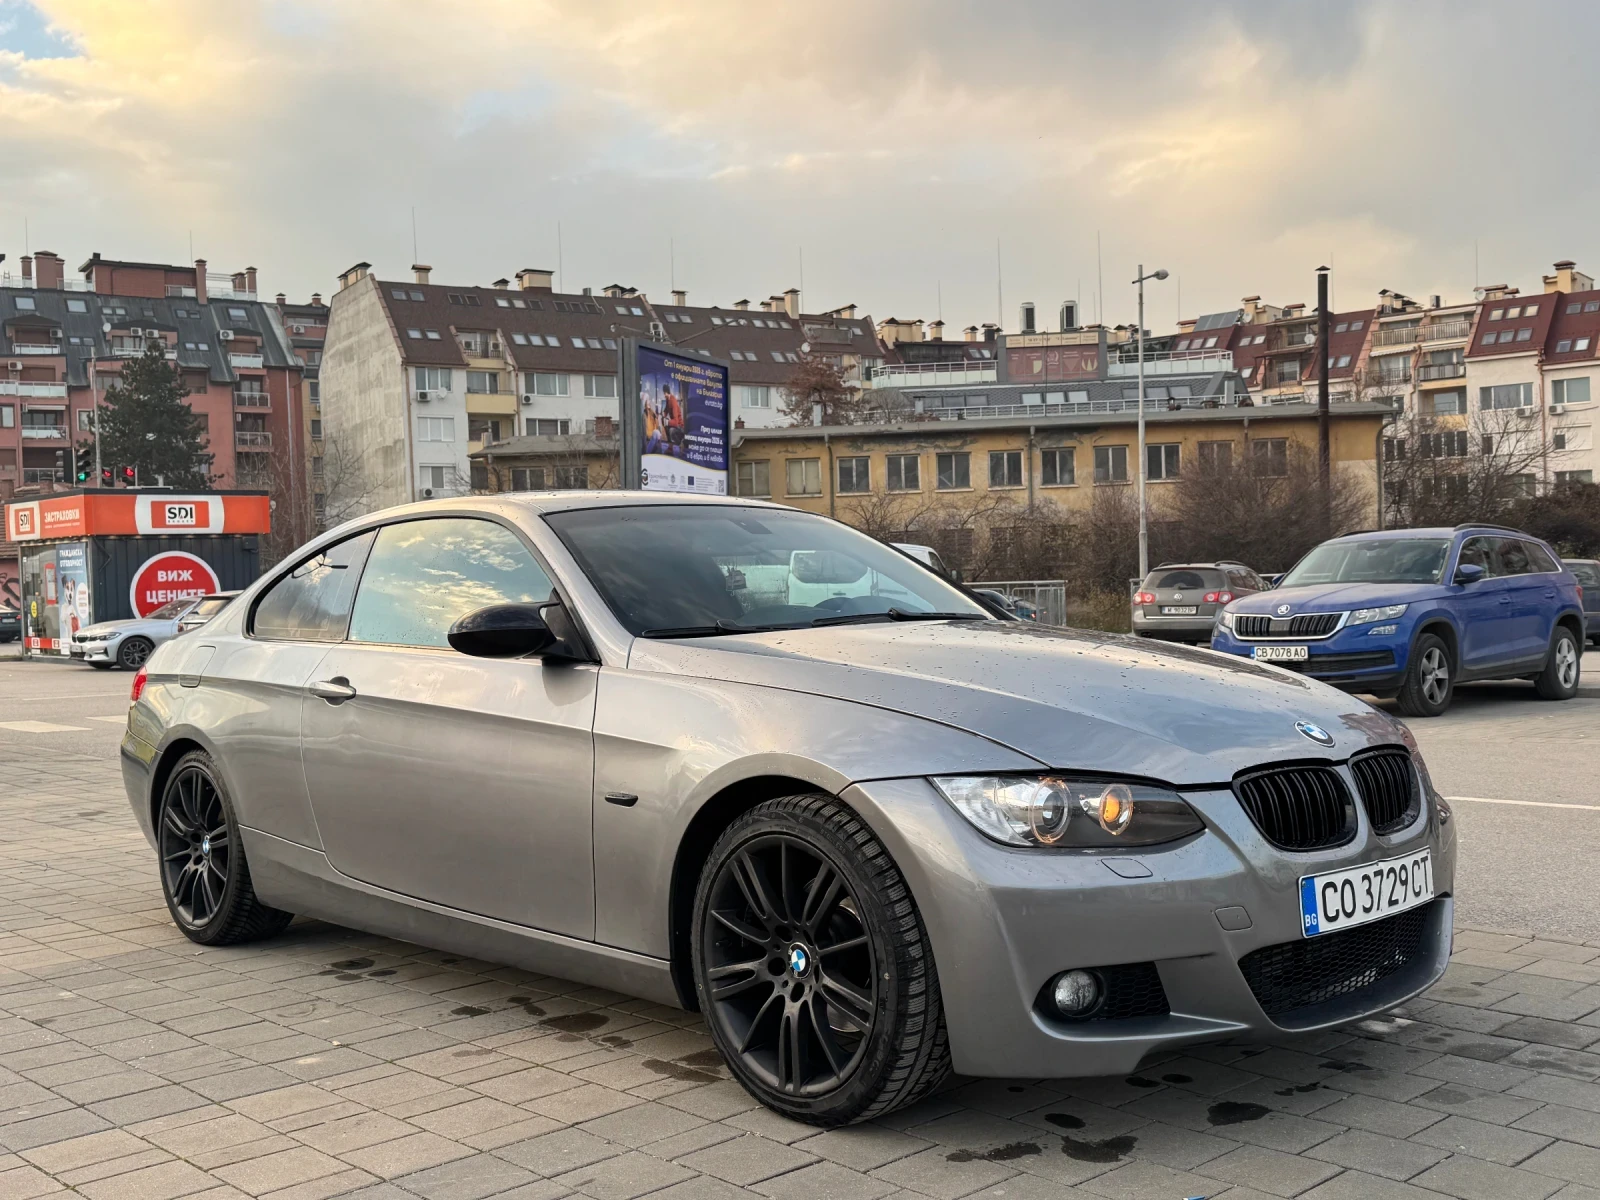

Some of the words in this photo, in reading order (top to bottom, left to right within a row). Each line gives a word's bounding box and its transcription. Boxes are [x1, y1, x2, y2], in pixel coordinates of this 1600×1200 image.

[20, 512, 30, 526] SDI
[44, 508, 80, 523] ЗАСТРАХОВКИ
[168, 506, 193, 519] SDI
[157, 570, 193, 582] ВИЖ
[1256, 648, 1268, 657] CB
[1270, 647, 1292, 657] 7078
[1294, 647, 1306, 657] AO
[1321, 878, 1356, 922] CO
[1361, 864, 1409, 914] 3729
[1412, 856, 1429, 897] CT
[1305, 913, 1317, 927] BG
